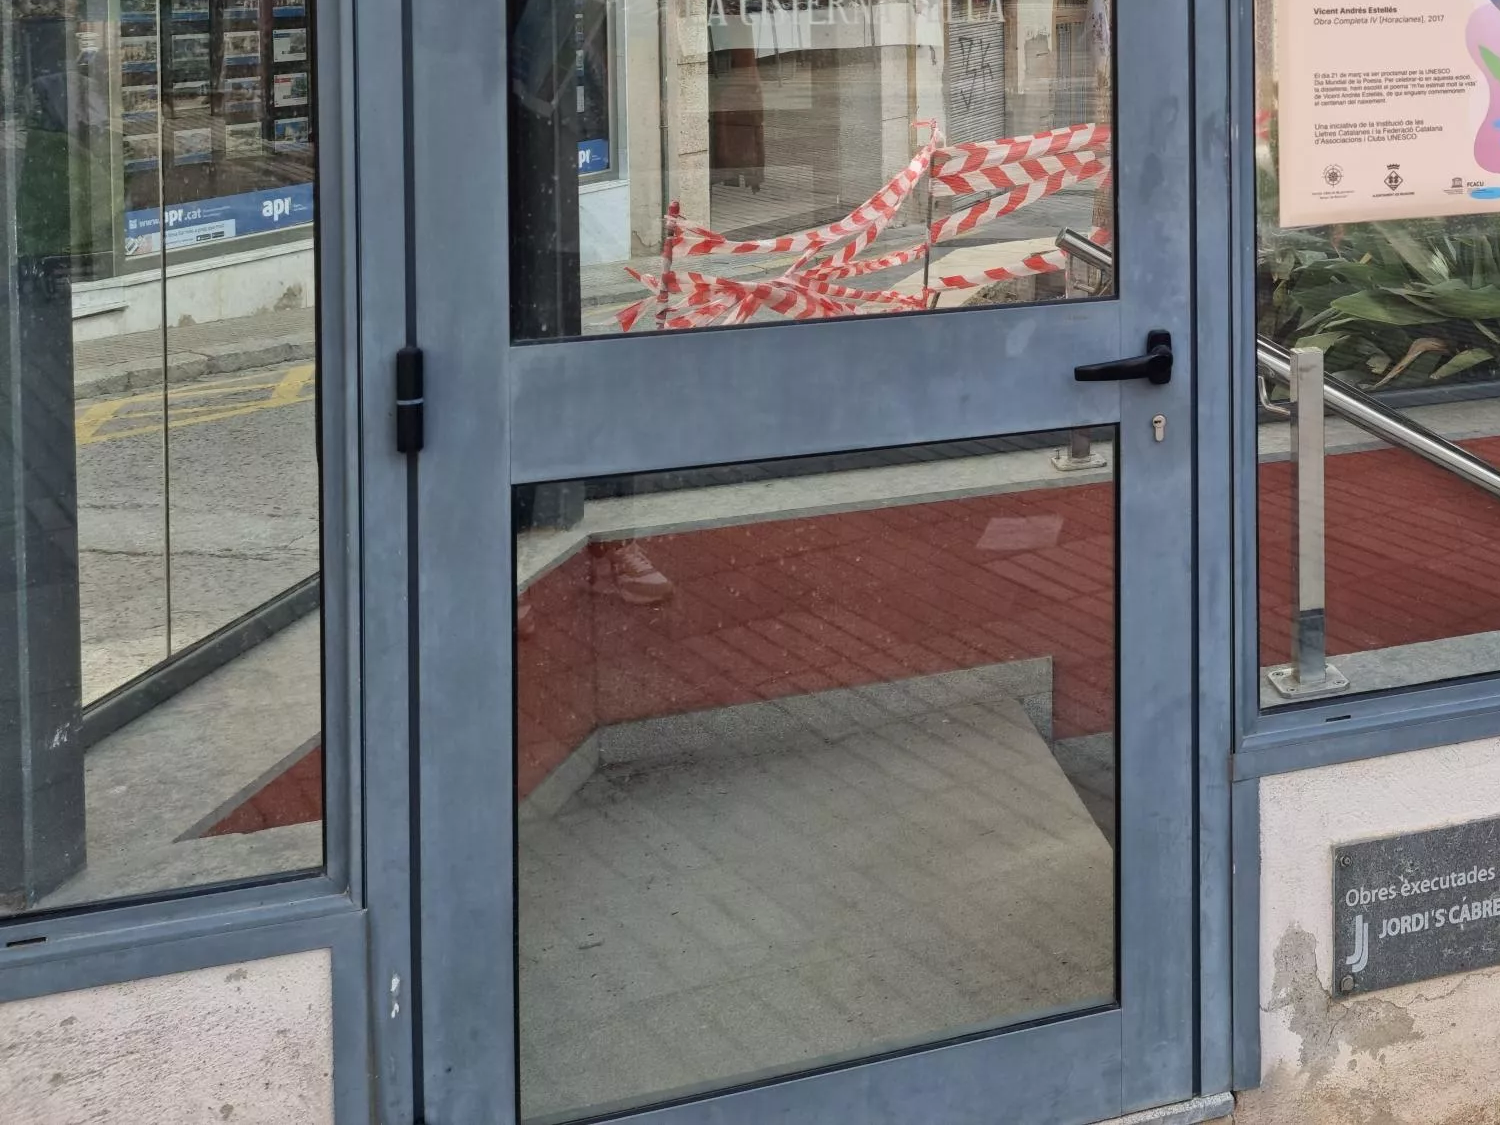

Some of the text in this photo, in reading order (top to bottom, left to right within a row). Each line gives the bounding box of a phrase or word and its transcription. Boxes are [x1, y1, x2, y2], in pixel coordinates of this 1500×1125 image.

[1368, 6, 1398, 14] Estellés
[1333, 17, 1369, 27] Completa
[262, 197, 292, 222] apr
[1345, 885, 1396, 907] Obres
[1401, 865, 1495, 897] executades
